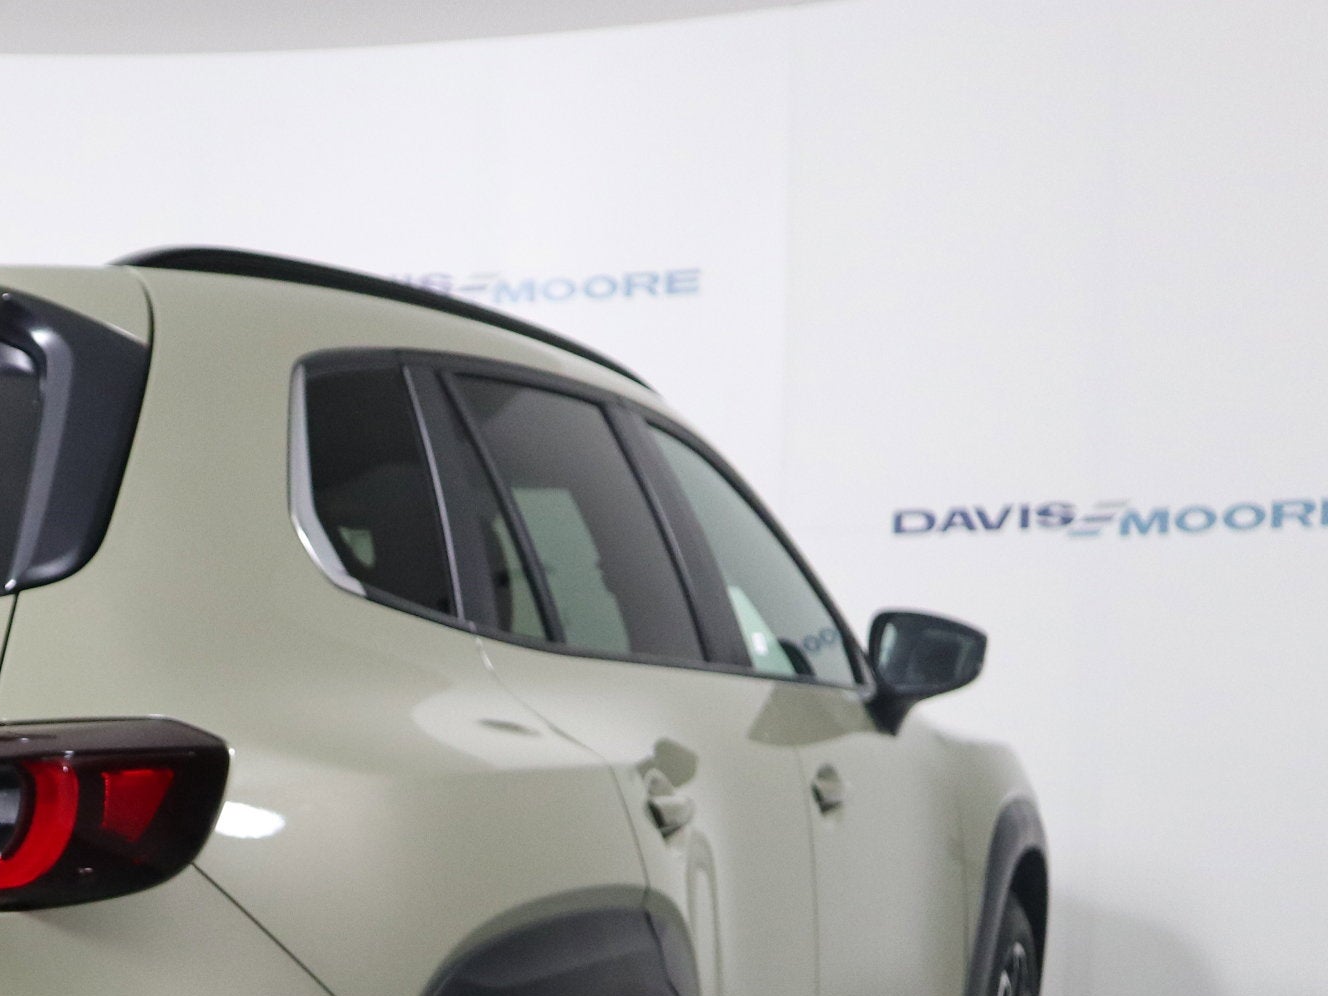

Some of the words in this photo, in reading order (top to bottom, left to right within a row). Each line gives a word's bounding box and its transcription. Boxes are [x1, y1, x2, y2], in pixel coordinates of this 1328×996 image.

[493, 267, 702, 304] MOORE
[892, 501, 1074, 536] DAVIS
[1119, 496, 1328, 537] MOOR
